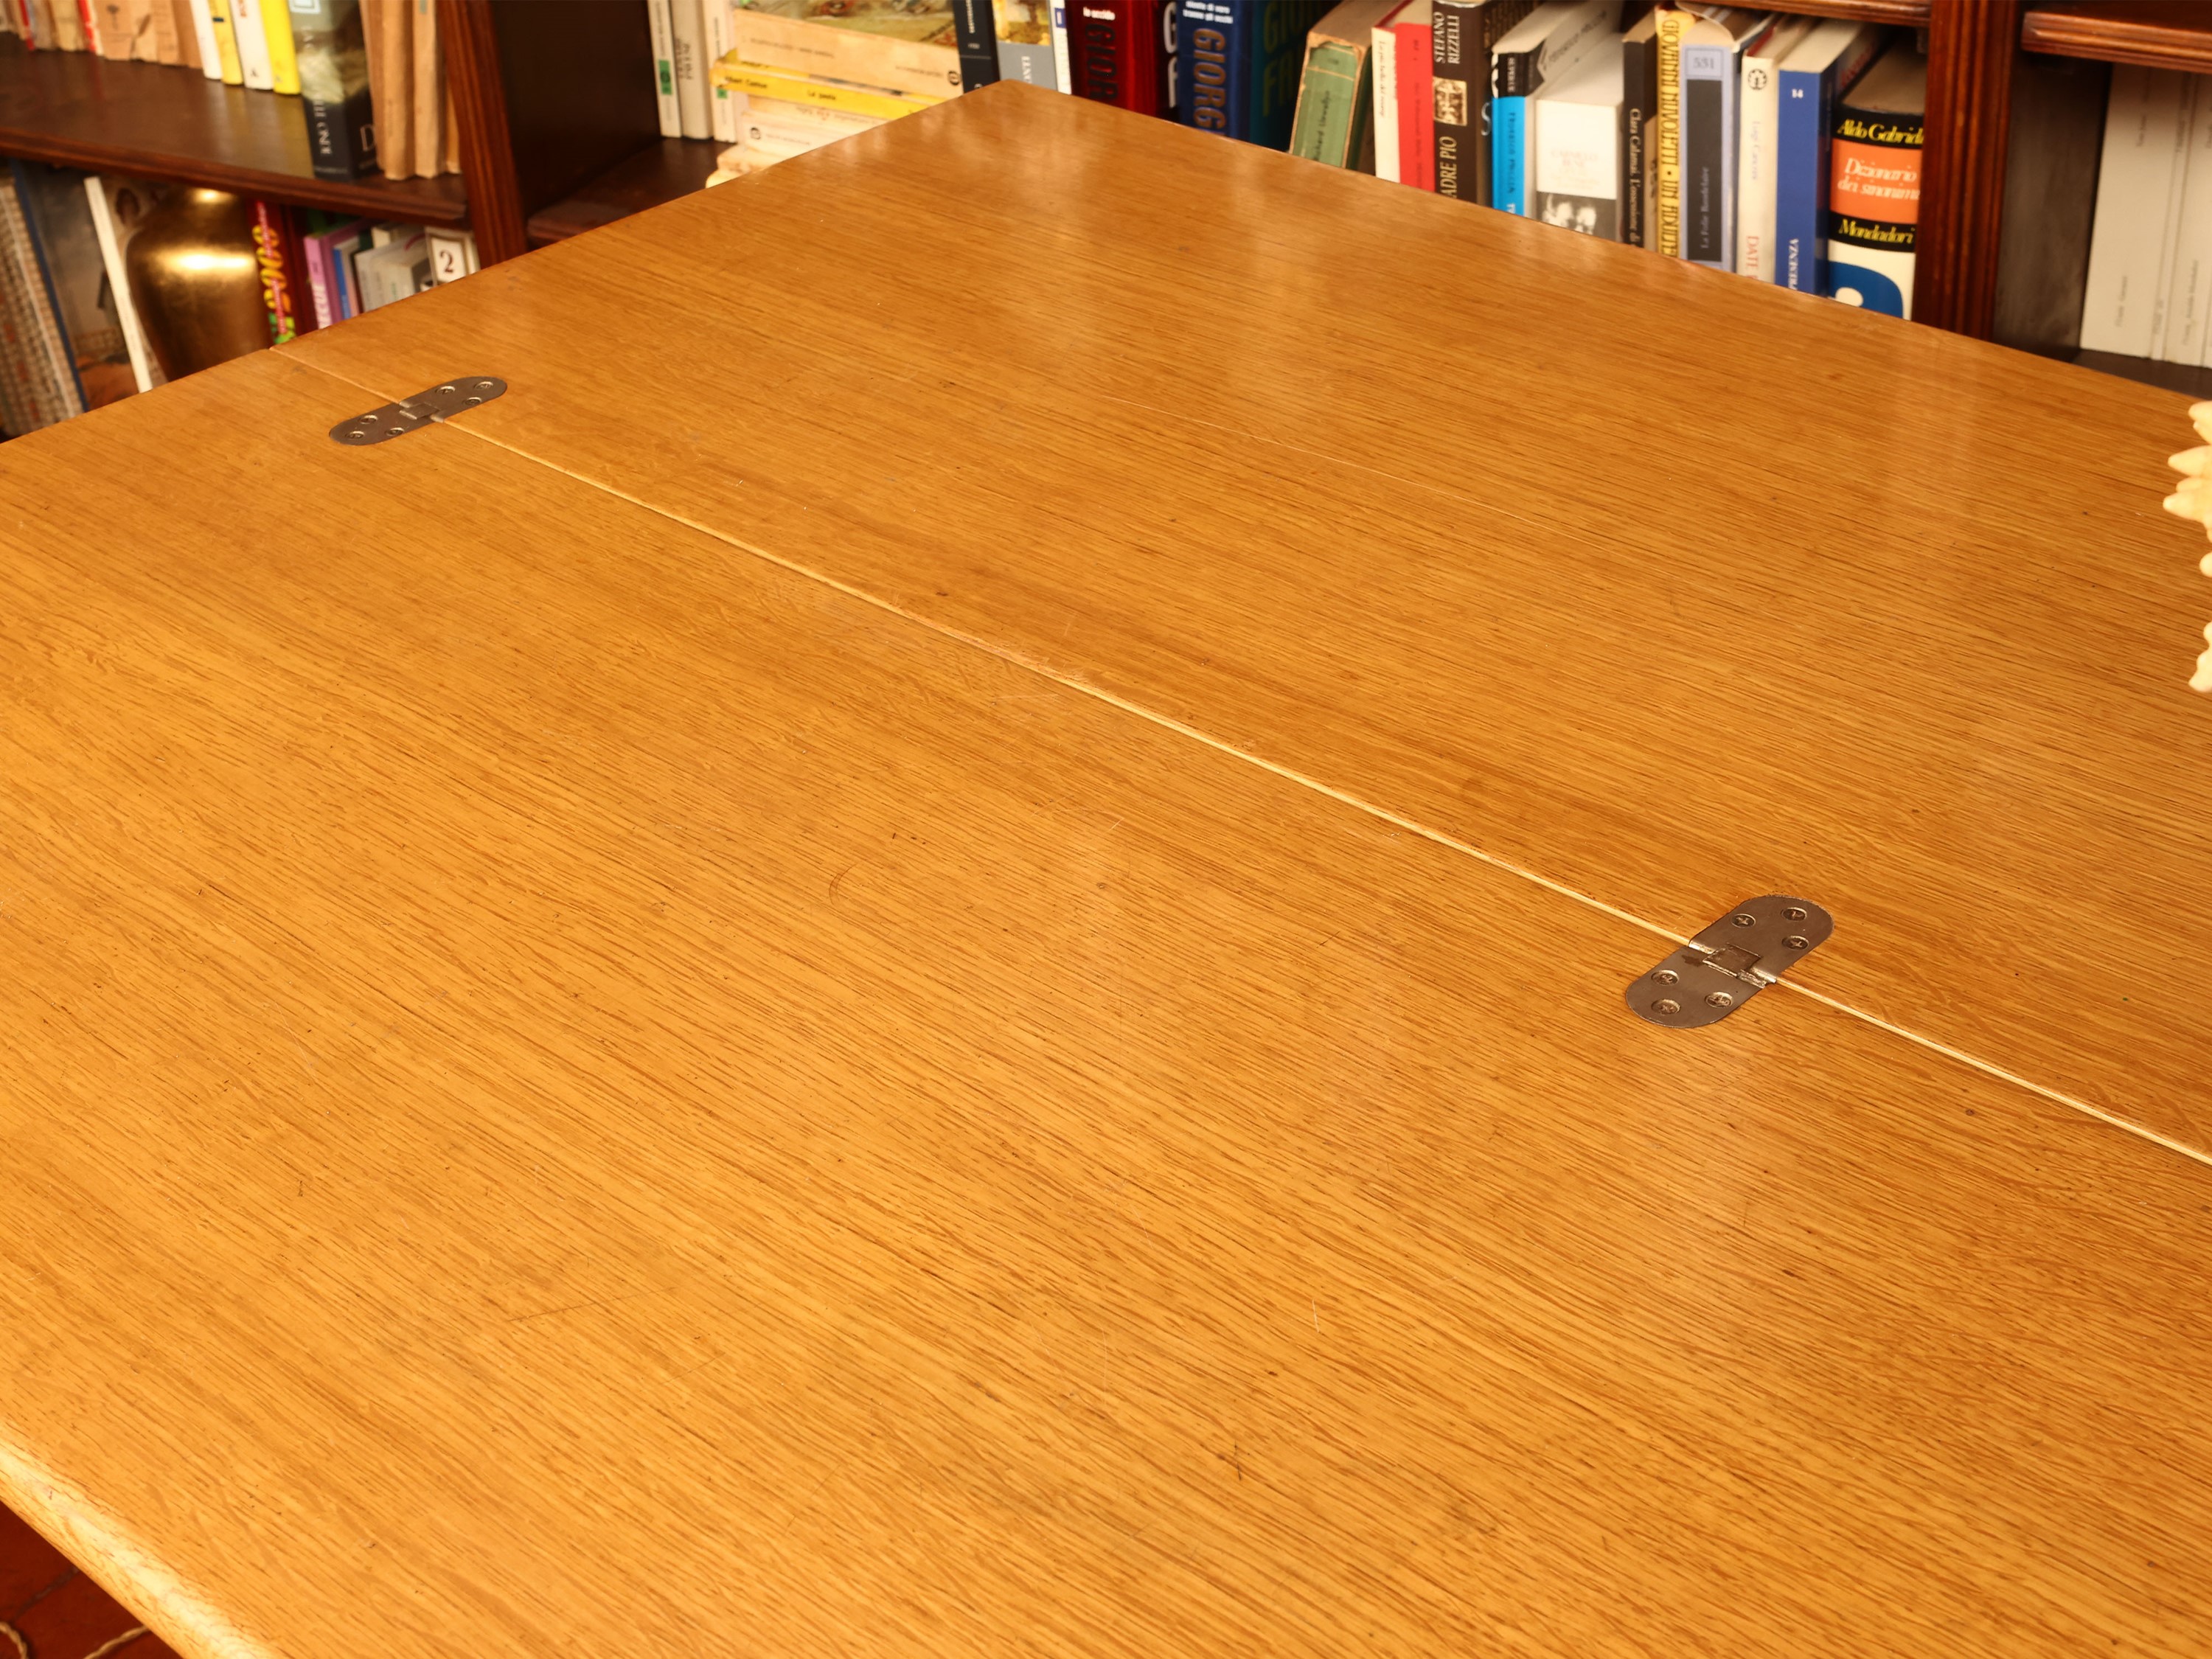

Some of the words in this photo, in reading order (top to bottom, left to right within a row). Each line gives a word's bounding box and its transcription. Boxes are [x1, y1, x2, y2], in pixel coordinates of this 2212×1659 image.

[1433, 10, 1446, 64] STEFANO
[1446, 14, 1461, 65] RIZZELLI
[1662, 19, 1680, 87] GIOVANNI
[1629, 108, 1642, 134] Clara
[1661, 91, 1679, 166] NUVOLETTI
[1837, 119, 1868, 140] Aldo
[1439, 135, 1458, 160] PIO
[1844, 158, 1918, 182] Dizionario
[1837, 175, 1858, 193] dei
[1860, 178, 1920, 201] sinonim
[1838, 218, 1916, 244] Mondadori
[438, 248, 456, 274] 2
[1745, 235, 1760, 269] DATE
